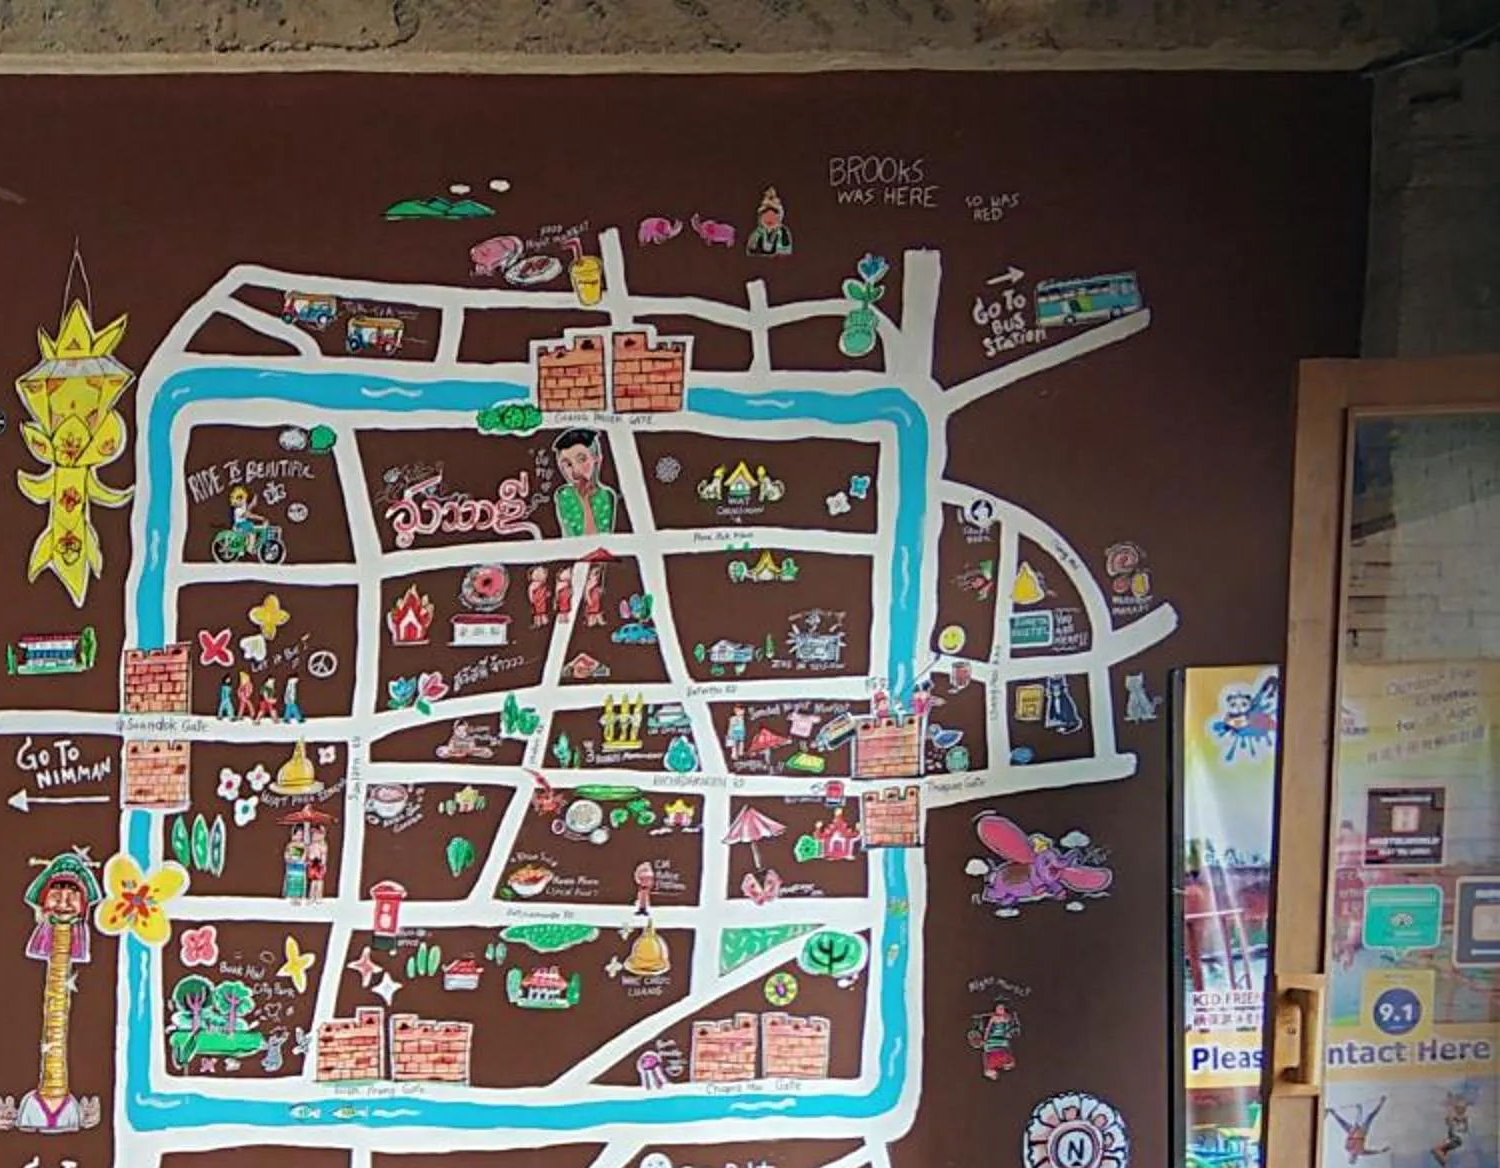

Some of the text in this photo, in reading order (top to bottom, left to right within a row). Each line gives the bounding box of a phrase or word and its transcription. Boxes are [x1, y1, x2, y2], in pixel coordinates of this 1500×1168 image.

[837, 185, 940, 208] WAS HERE
[187, 465, 225, 504] RIDE
[36, 756, 112, 790] NIMMAN
[1378, 1002, 1415, 1022] 9.1
[1192, 1038, 1491, 1071] Pleas ntact Here
[1068, 1139, 1084, 1161] N
